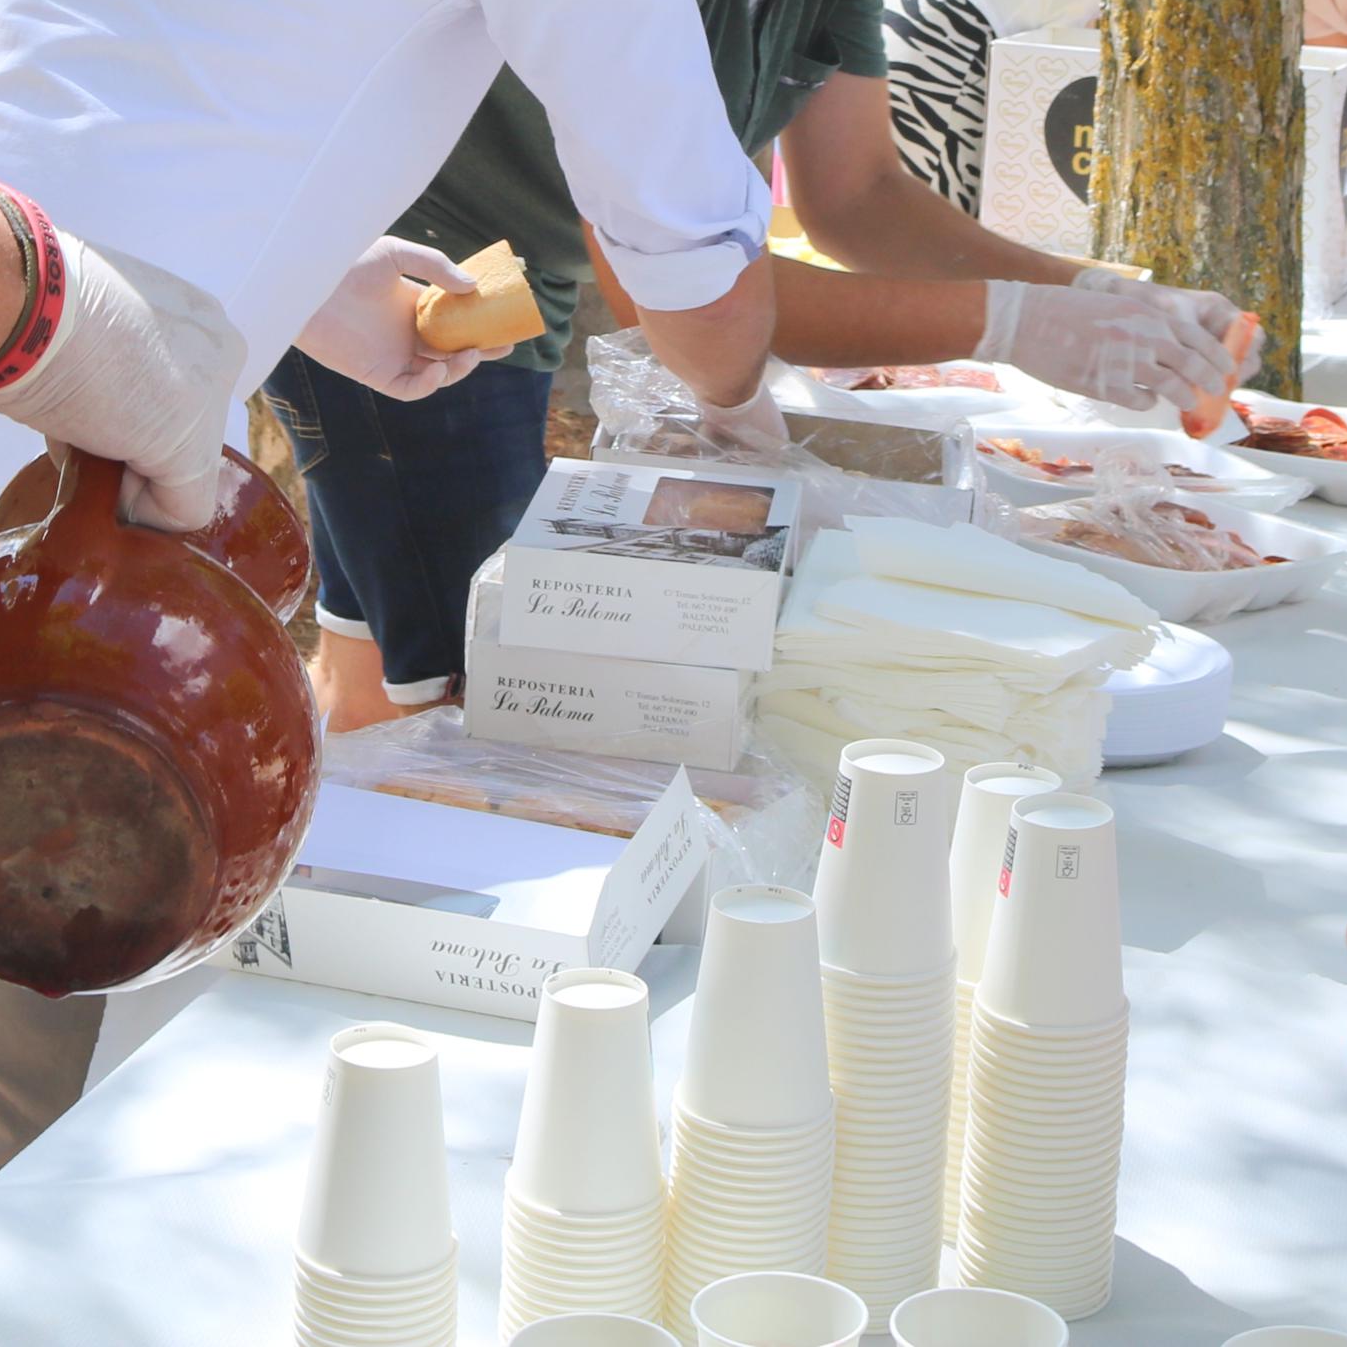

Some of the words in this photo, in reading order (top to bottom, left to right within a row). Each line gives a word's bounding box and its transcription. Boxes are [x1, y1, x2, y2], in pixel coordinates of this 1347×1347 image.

[532, 578, 632, 598] REPOSTERIA
[526, 592, 554, 615] La
[561, 597, 632, 622] Paloma
[497, 676, 595, 698] REPOSTERIA
[492, 689, 519, 712] La
[525, 695, 595, 722] Paloma
[430, 939, 521, 977] Paloma
[435, 970, 543, 999] POSTERIA
